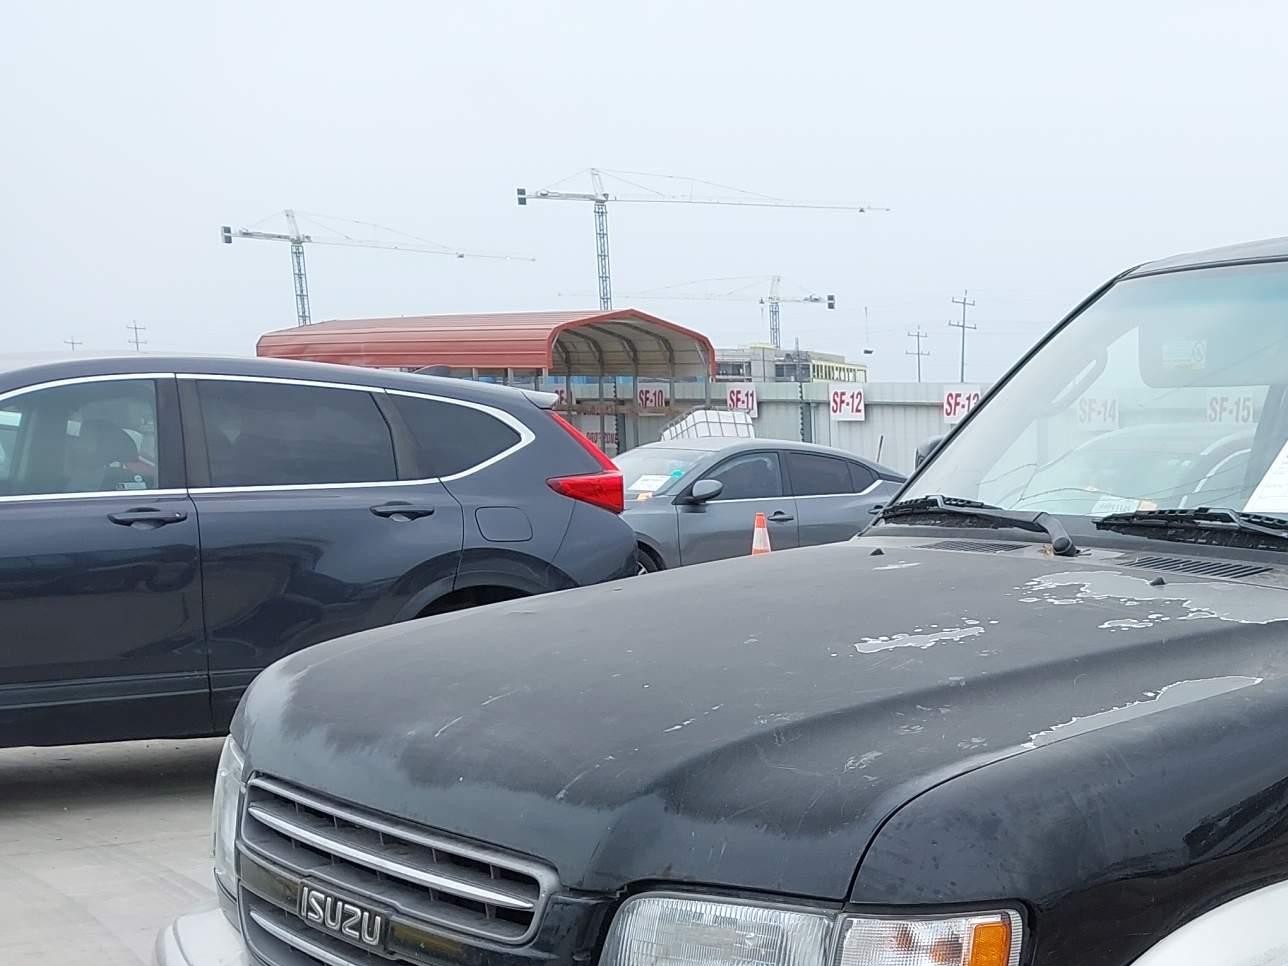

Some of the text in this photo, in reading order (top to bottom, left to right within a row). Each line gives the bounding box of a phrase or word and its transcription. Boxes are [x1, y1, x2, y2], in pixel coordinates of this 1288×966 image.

[639, 389, 664, 408] SF-10
[729, 389, 754, 410] SF-11
[832, 391, 862, 413] SF-12
[1208, 396, 1252, 423] SF-15
[1079, 398, 1117, 423] SF-14
[301, 886, 381, 946] ISUZU
